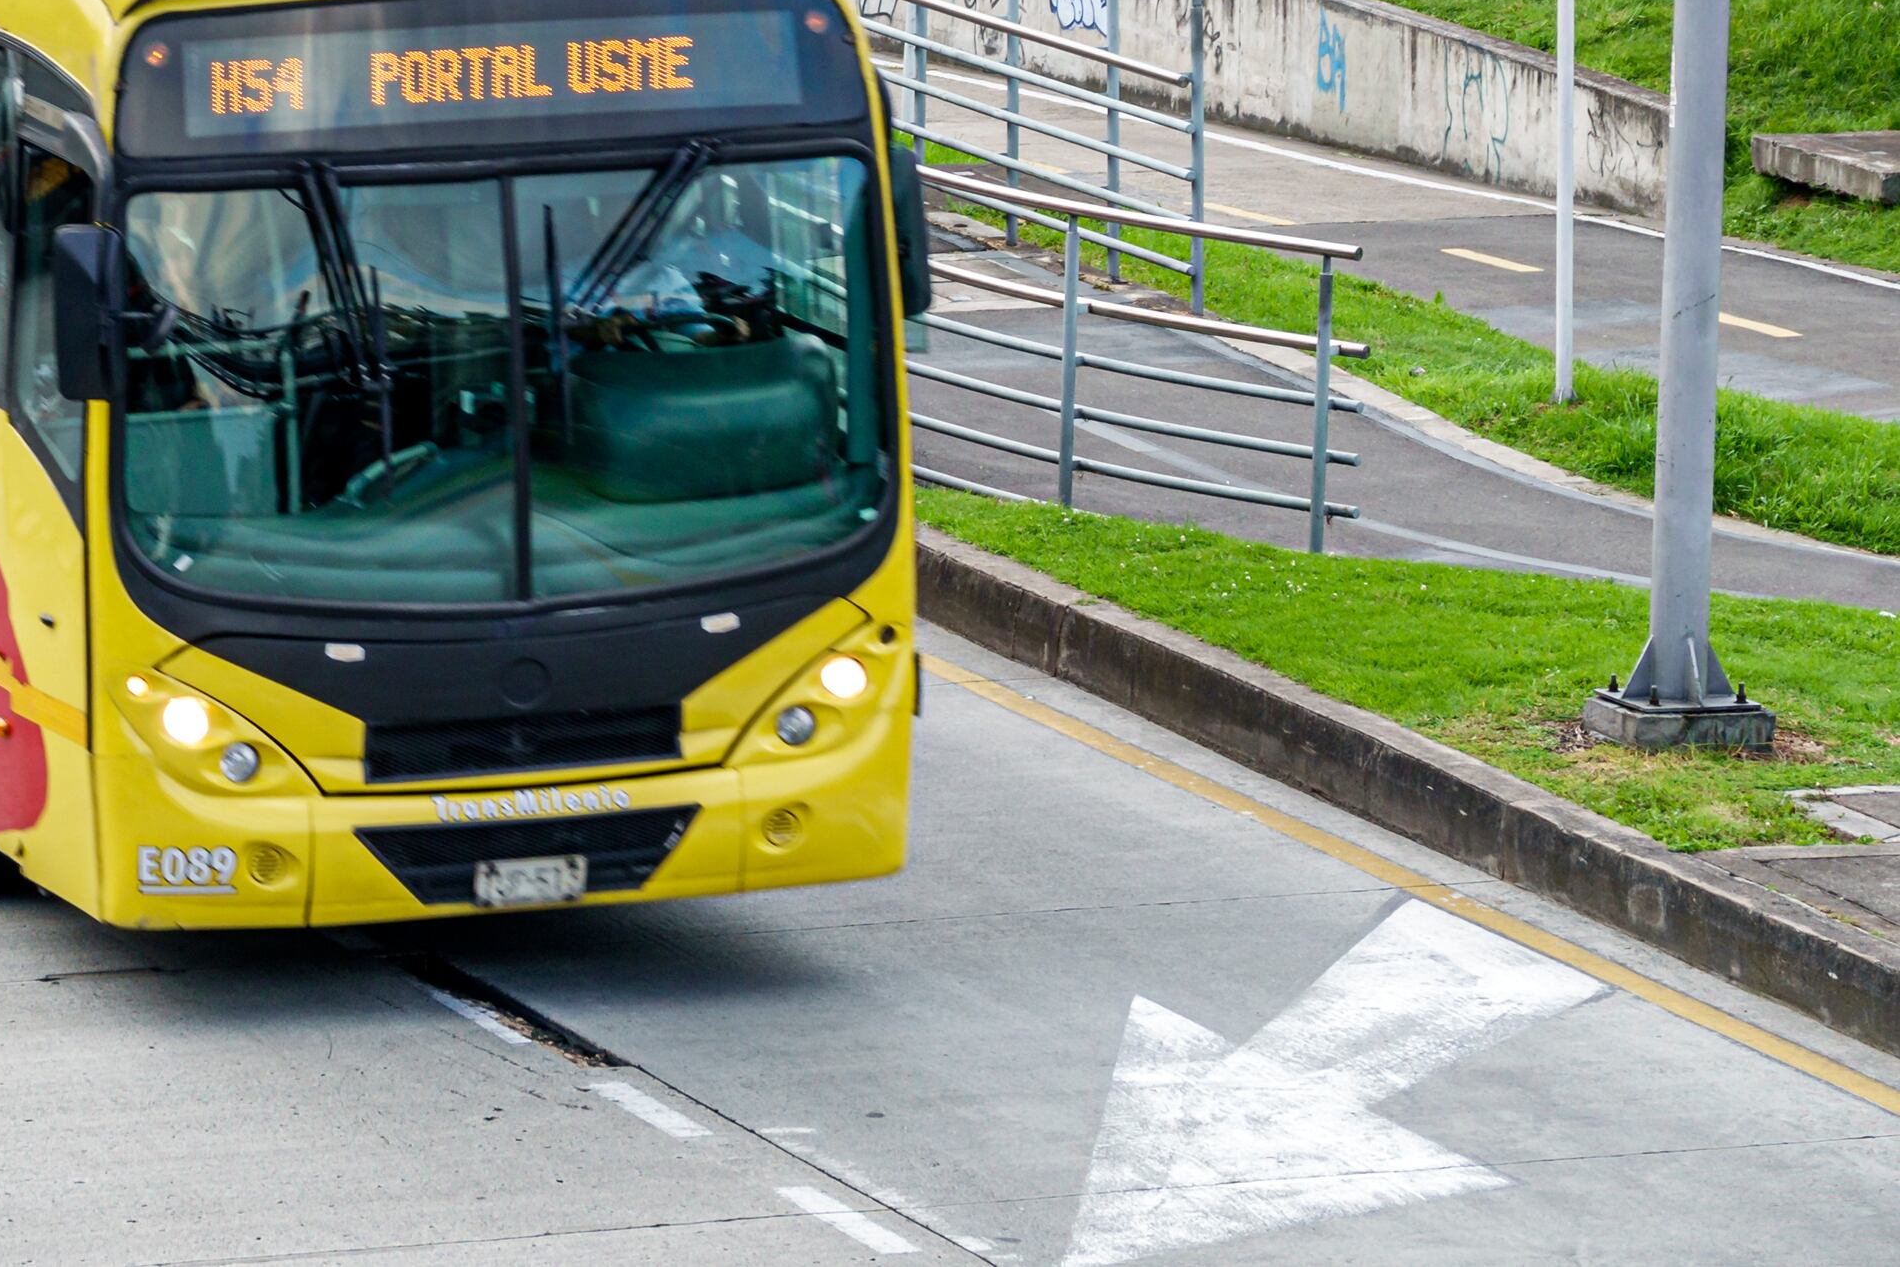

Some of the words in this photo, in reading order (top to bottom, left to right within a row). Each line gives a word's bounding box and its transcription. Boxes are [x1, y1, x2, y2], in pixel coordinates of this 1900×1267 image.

[210, 57, 304, 115] H54
[370, 44, 553, 107] PORTAL
[567, 35, 694, 95] USME
[430, 783, 630, 823] TransMilenio
[138, 844, 237, 887] E089
